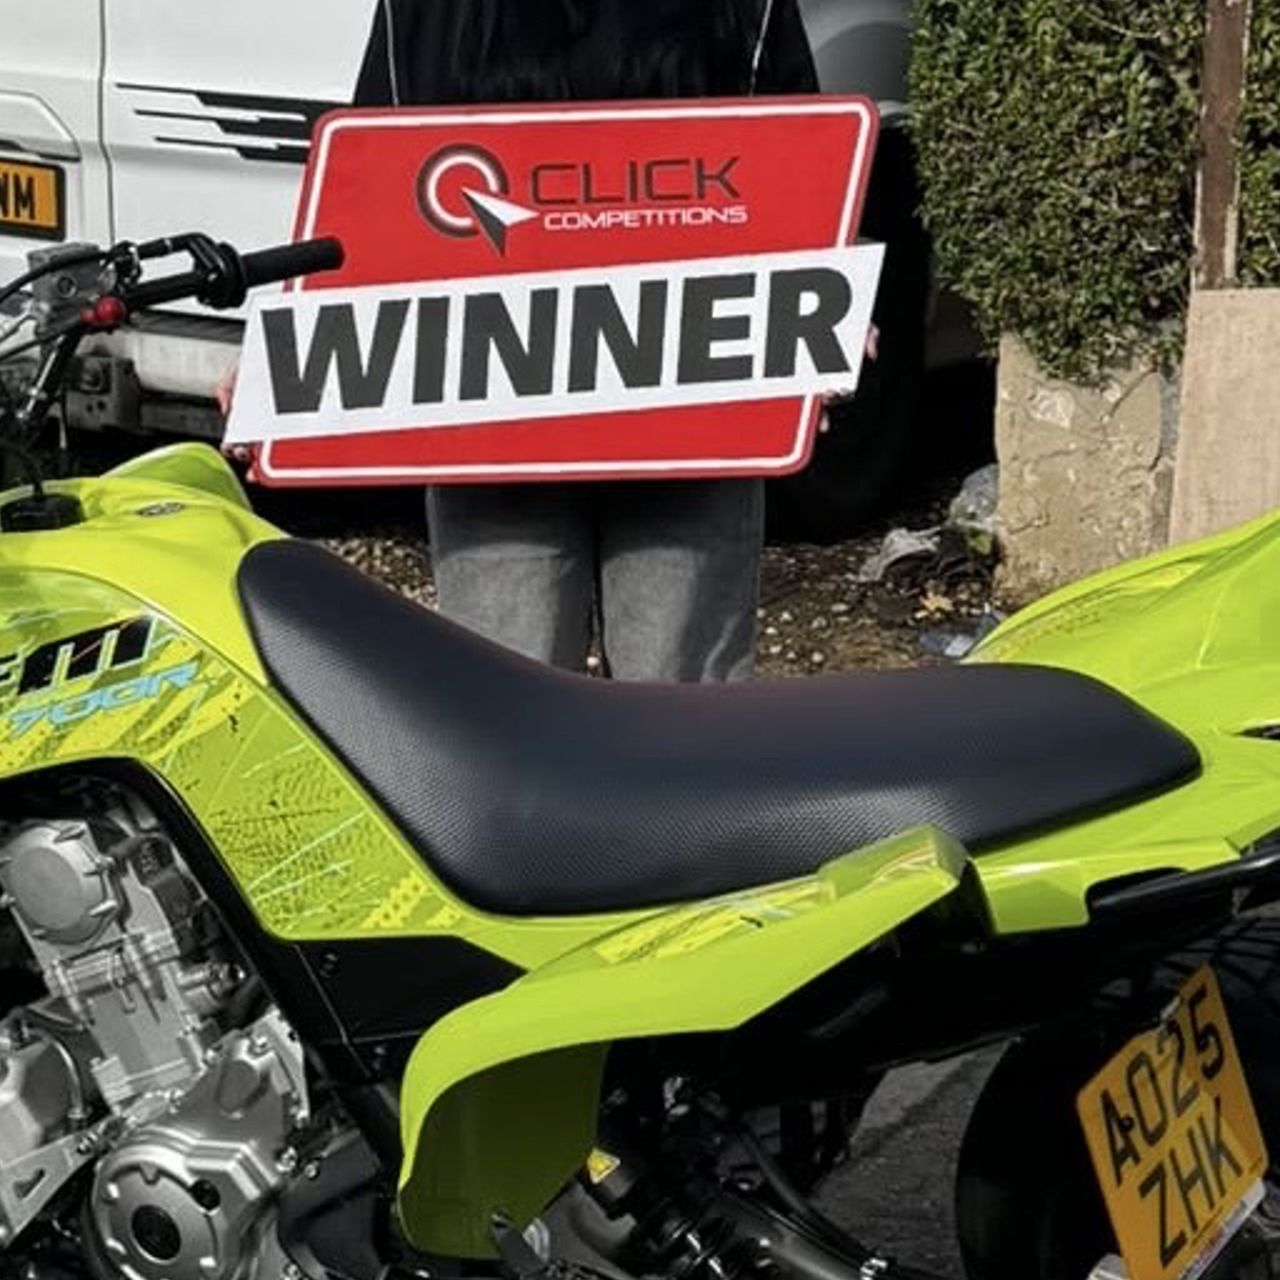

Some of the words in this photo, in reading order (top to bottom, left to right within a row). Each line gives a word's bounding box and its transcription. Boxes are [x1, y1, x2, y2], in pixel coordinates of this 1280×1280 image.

[530, 156, 742, 206] CLICK
[543, 205, 749, 232] COMPETITIONS
[260, 266, 854, 416] WINNER
[1138, 1094, 1244, 1270] ZHK
